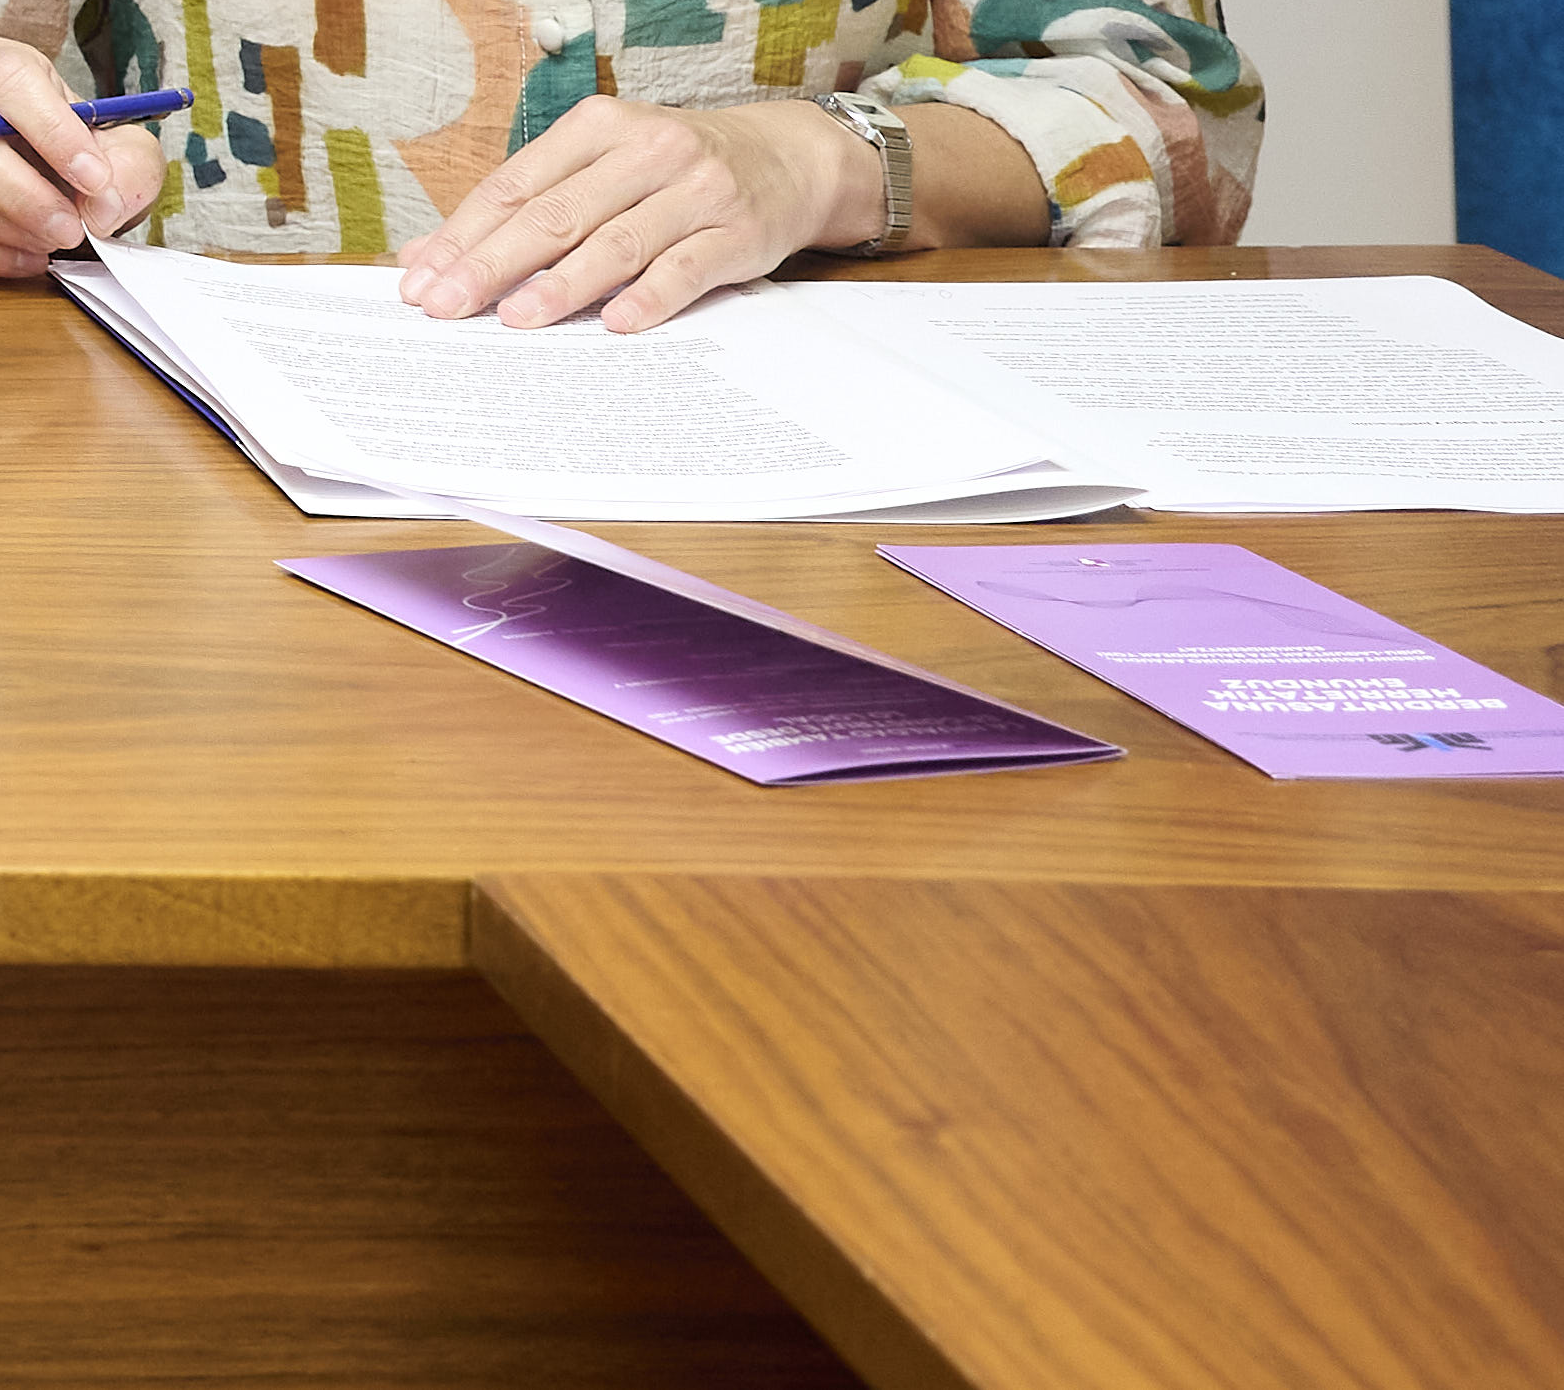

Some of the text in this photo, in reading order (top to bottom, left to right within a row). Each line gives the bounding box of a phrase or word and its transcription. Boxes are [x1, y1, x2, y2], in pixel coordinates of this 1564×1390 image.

[1219, 677, 1408, 690] EHUNDUZ
[1205, 688, 1463, 701] HERRIETATIK
[1201, 698, 1509, 712] BERDINTASUNA
[709, 725, 802, 745] DESDE
[724, 732, 850, 755] TAMBIÉN
